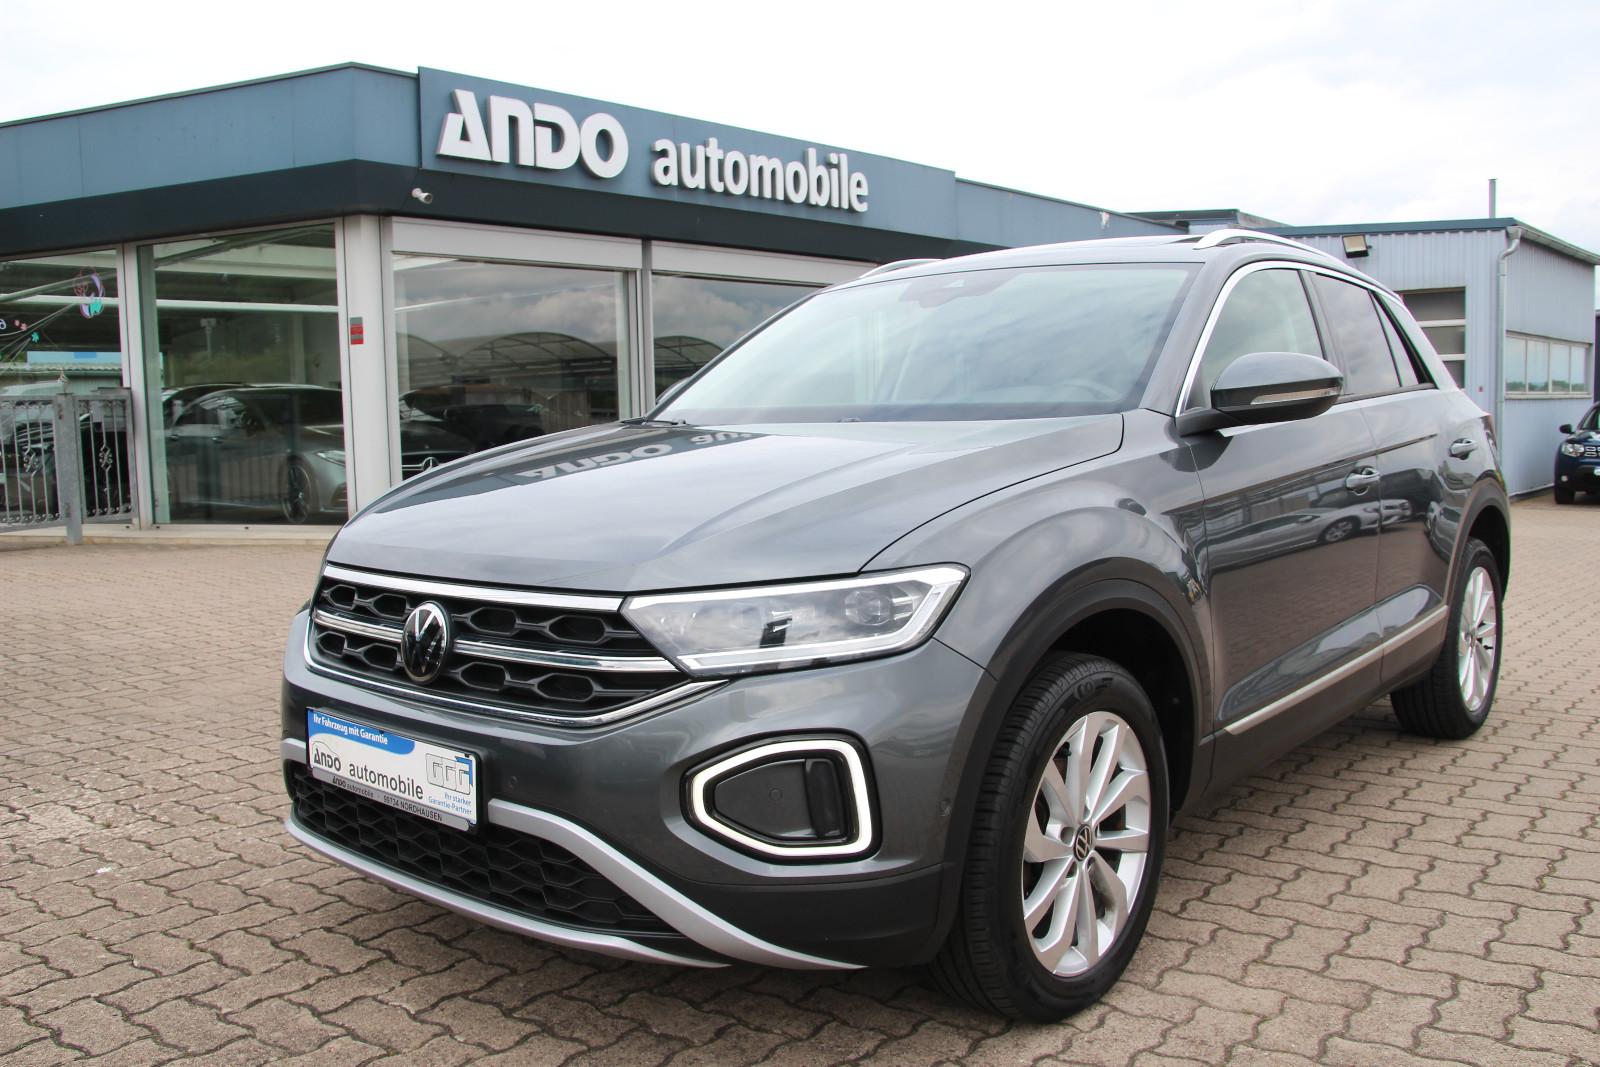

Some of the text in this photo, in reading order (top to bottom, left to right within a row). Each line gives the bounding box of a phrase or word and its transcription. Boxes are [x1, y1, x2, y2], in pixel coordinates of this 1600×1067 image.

[435, 88, 869, 213] ANDO automobile
[313, 713, 388, 745] Ihr Fahrzeug mit Garantie
[313, 747, 424, 800] ANDO automobile
[383, 794, 399, 807] 99734
[400, 801, 443, 821] NORDHAUSEN
[444, 791, 452, 801] Ihr
